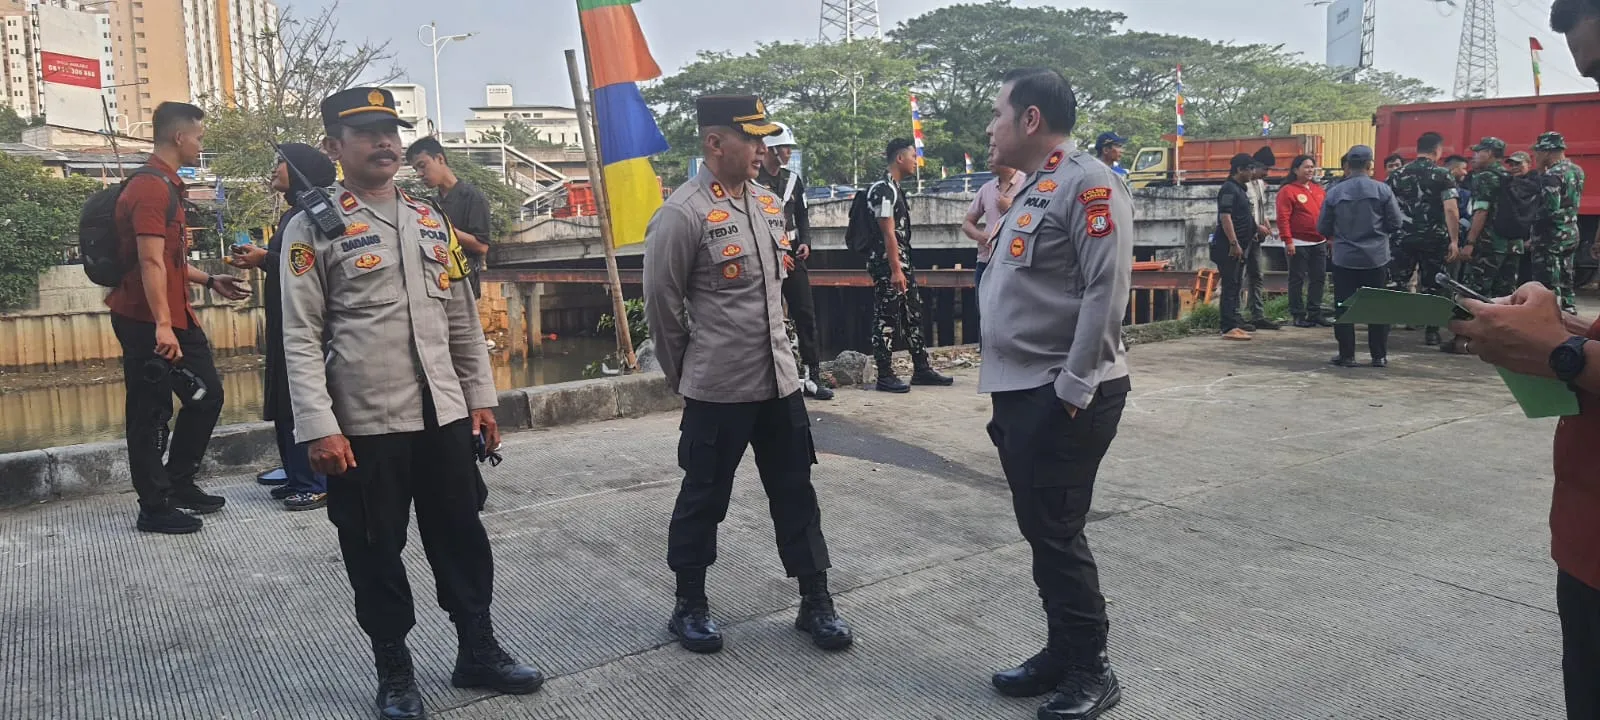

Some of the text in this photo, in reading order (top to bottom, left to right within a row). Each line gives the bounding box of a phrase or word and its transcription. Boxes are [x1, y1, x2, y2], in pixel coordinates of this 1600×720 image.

[1024, 197, 1050, 208] POLRI
[420, 229, 447, 242] POLRI
[709, 226, 739, 239] TEDJO
[342, 235, 381, 252] DADANG
